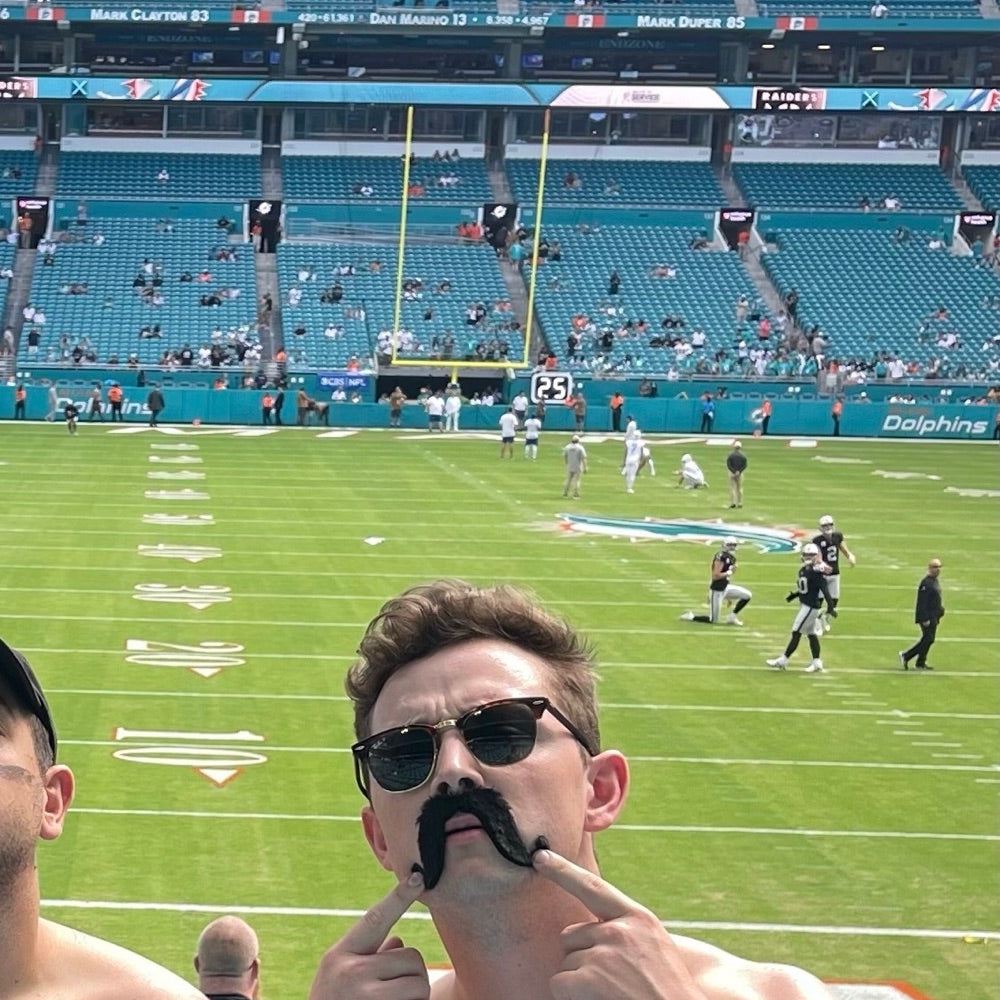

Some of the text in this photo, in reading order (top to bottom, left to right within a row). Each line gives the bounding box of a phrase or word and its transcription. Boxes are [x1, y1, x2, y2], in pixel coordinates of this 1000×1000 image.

[190, 10, 209, 22] 83
[452, 14, 467, 26] 13
[726, 18, 745, 29] 85
[761, 92, 818, 103] RAIDERS
[537, 377, 567, 400] 25
[882, 415, 989, 435] Dolphins
[125, 639, 246, 667] 20
[112, 728, 268, 767] 10
